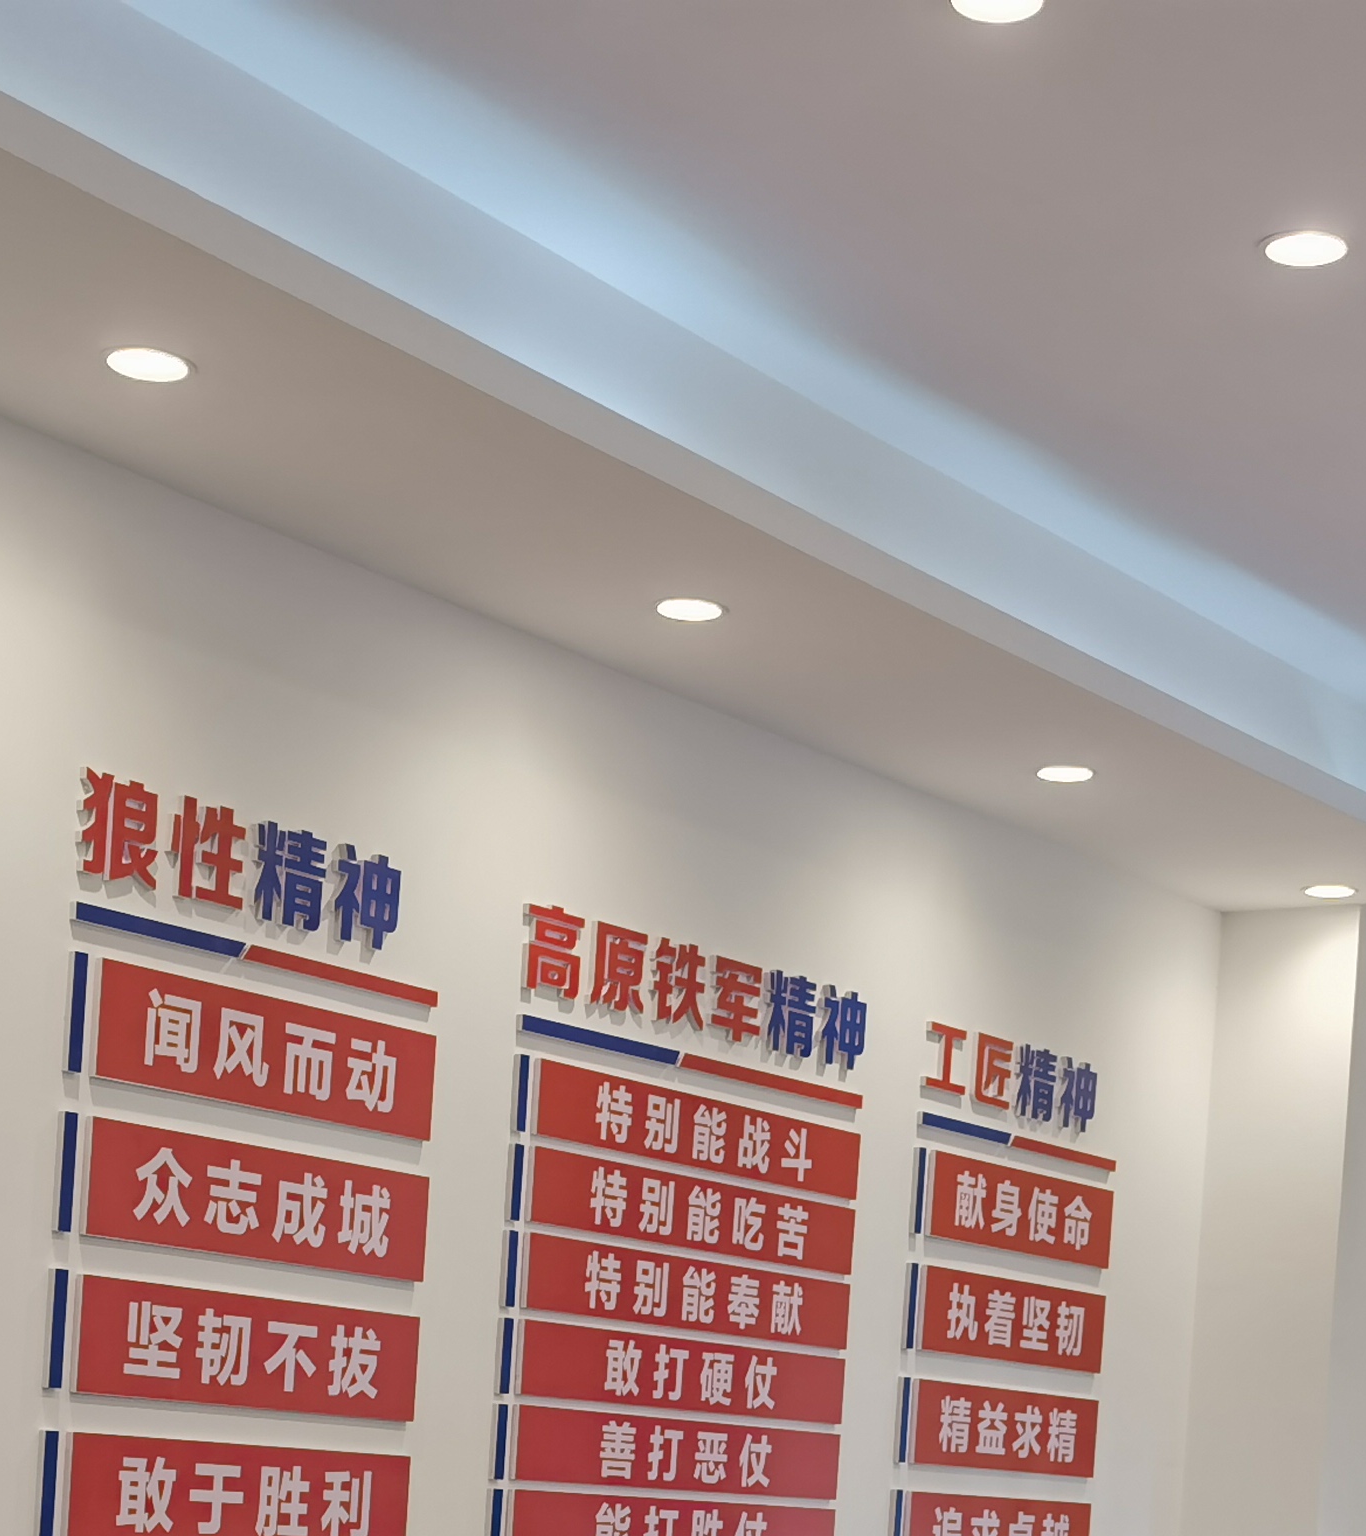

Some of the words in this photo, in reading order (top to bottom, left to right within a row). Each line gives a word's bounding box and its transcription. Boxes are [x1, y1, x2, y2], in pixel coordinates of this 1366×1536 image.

[77, 766, 402, 951] 狼性精神
[523, 903, 867, 1071] 高原铁军精神
[145, 989, 397, 1113] 闻风而动
[923, 1020, 1099, 1134] 工匠精神
[596, 1082, 812, 1182] 特别能战斗
[134, 1148, 391, 1258] 众志成城
[591, 1167, 808, 1260] 特别能吃苦
[955, 1171, 1092, 1250] 献身使命
[585, 1251, 803, 1335] 特别能奉献
[947, 1284, 1084, 1356] 执着坚韧
[124, 1302, 381, 1398] 坚韧不拔
[605, 1340, 777, 1409] 敢打硬仗
[600, 1421, 772, 1487] 善打恶仗
[939, 1396, 1077, 1463] 精益求精
